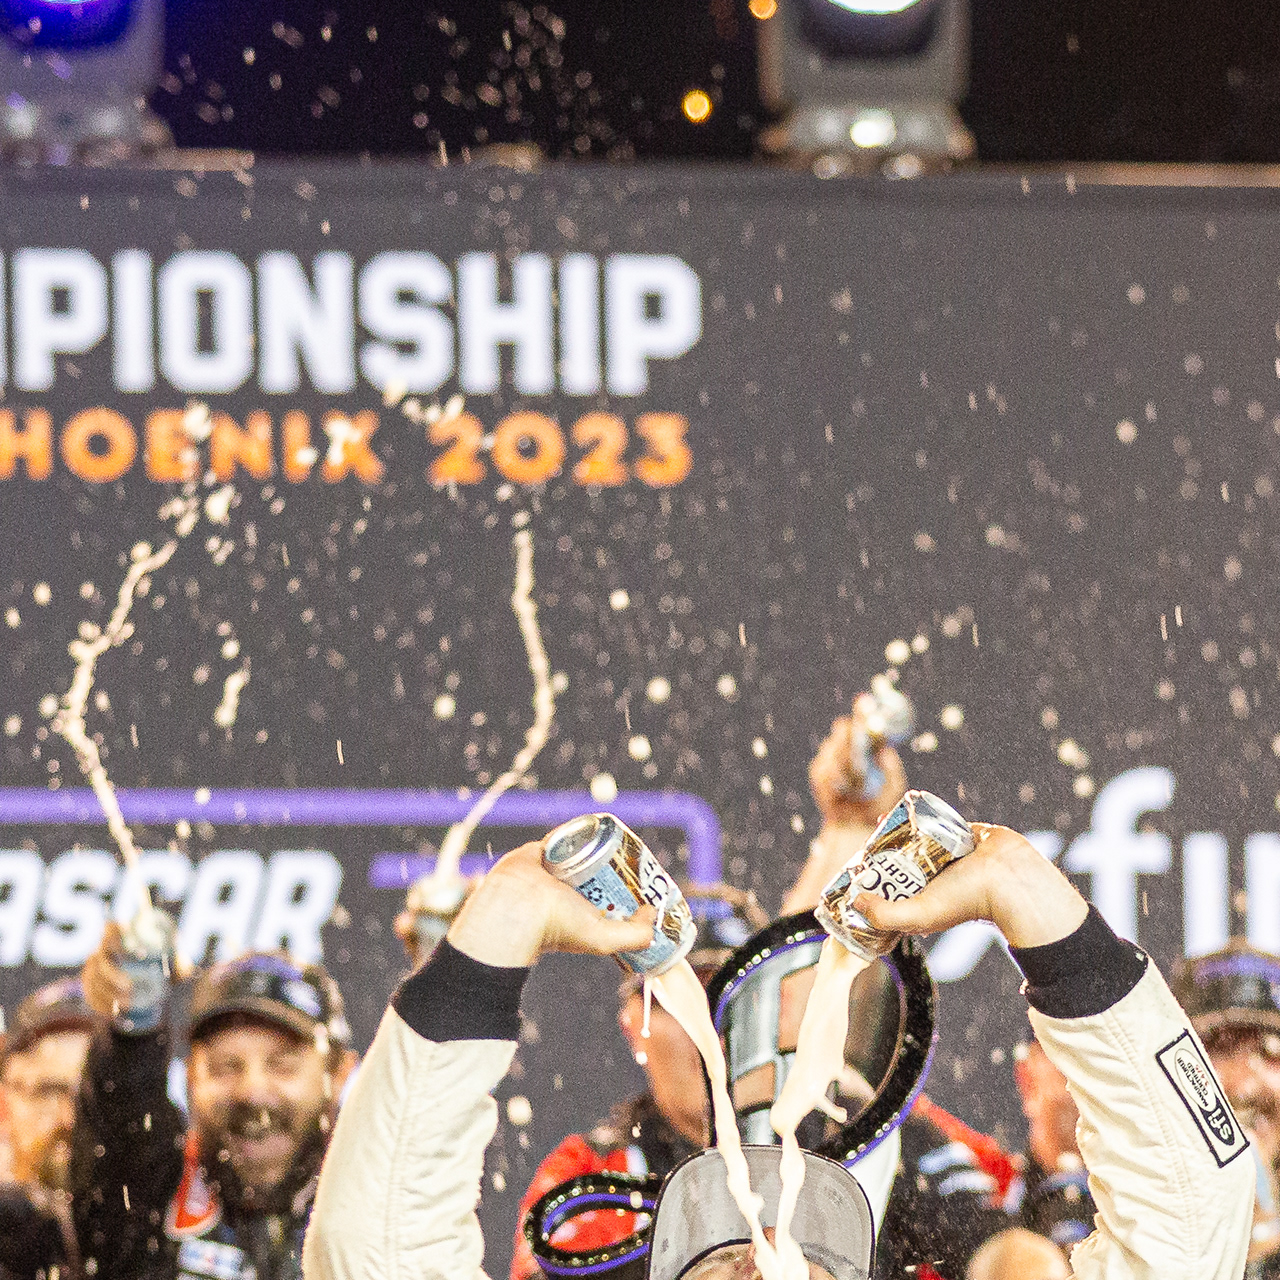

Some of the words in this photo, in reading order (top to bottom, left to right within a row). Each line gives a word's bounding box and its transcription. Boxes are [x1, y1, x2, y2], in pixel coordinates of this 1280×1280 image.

[428, 410, 693, 488] 2023
[876, 856, 925, 895] LIGHT
[1176, 1056, 1209, 1108] MANUFACTURER
